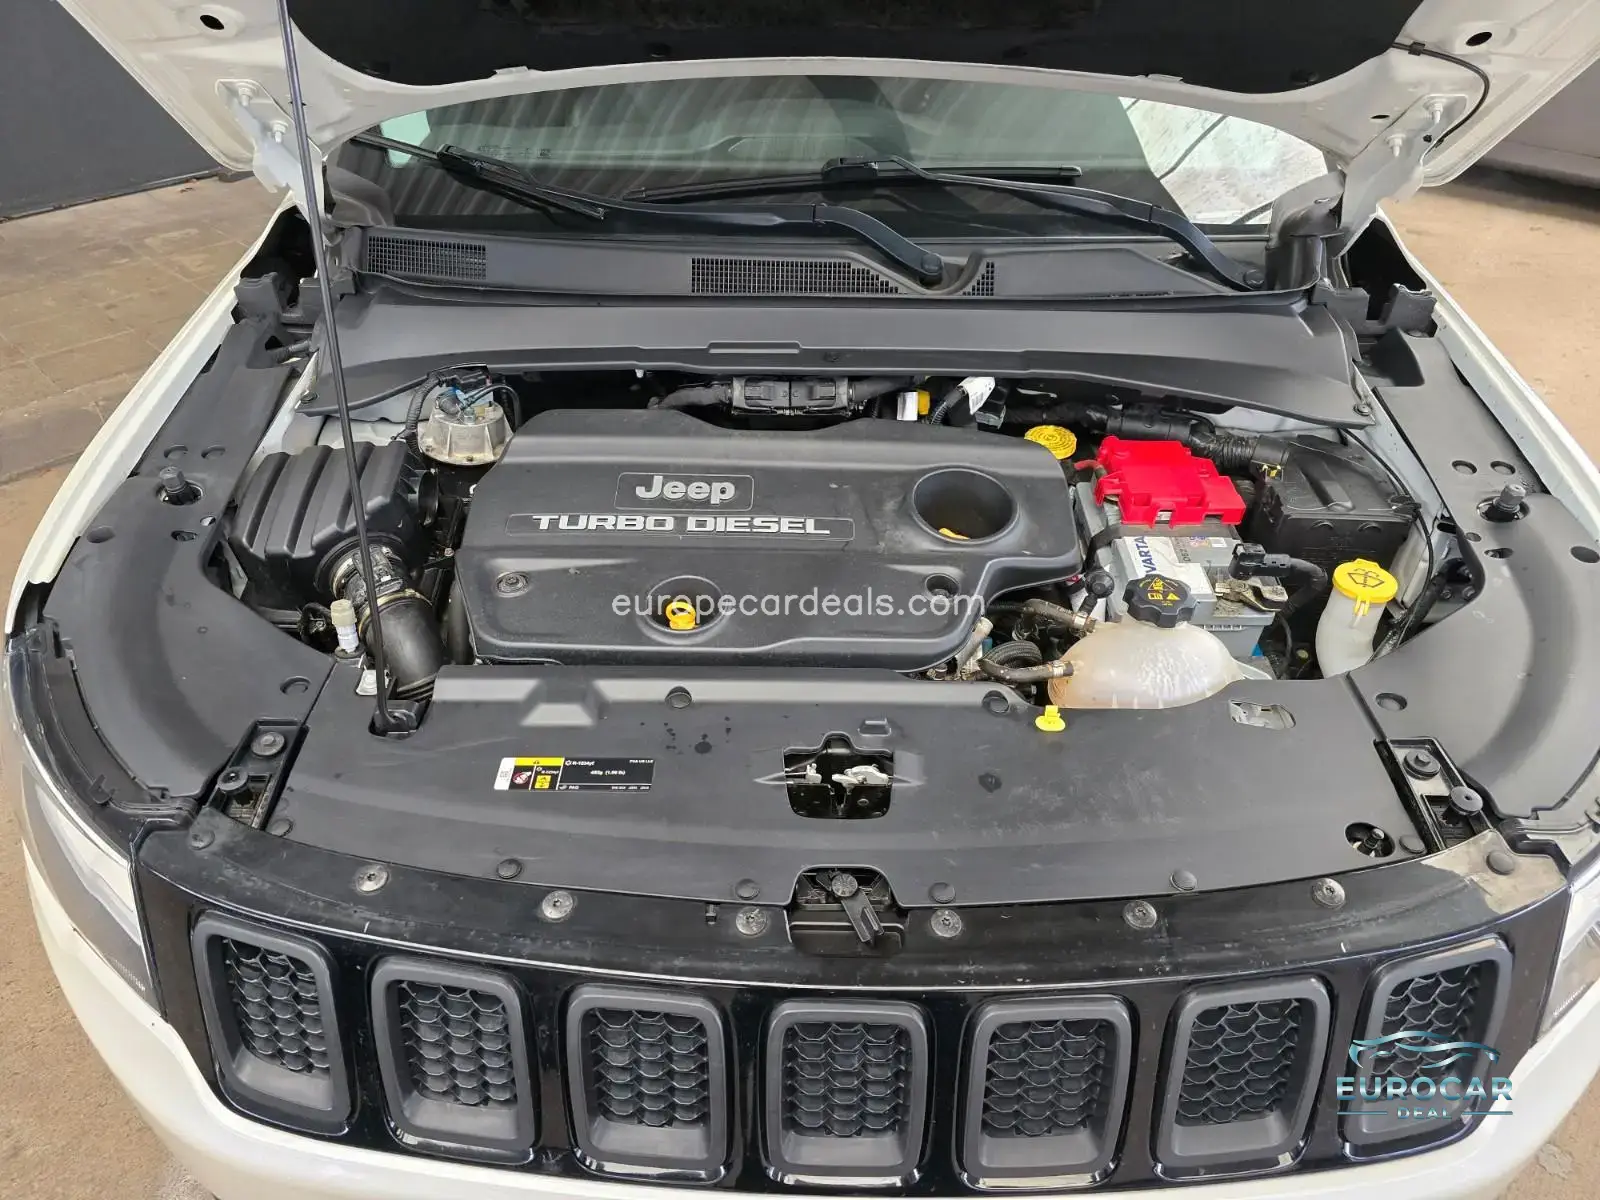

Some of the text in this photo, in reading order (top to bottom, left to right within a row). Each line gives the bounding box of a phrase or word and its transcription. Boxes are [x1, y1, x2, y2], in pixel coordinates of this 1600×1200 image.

[635, 475, 736, 505] Jeep
[532, 514, 830, 535] TURBO DIESEL
[1134, 536, 1157, 573] VARTA
